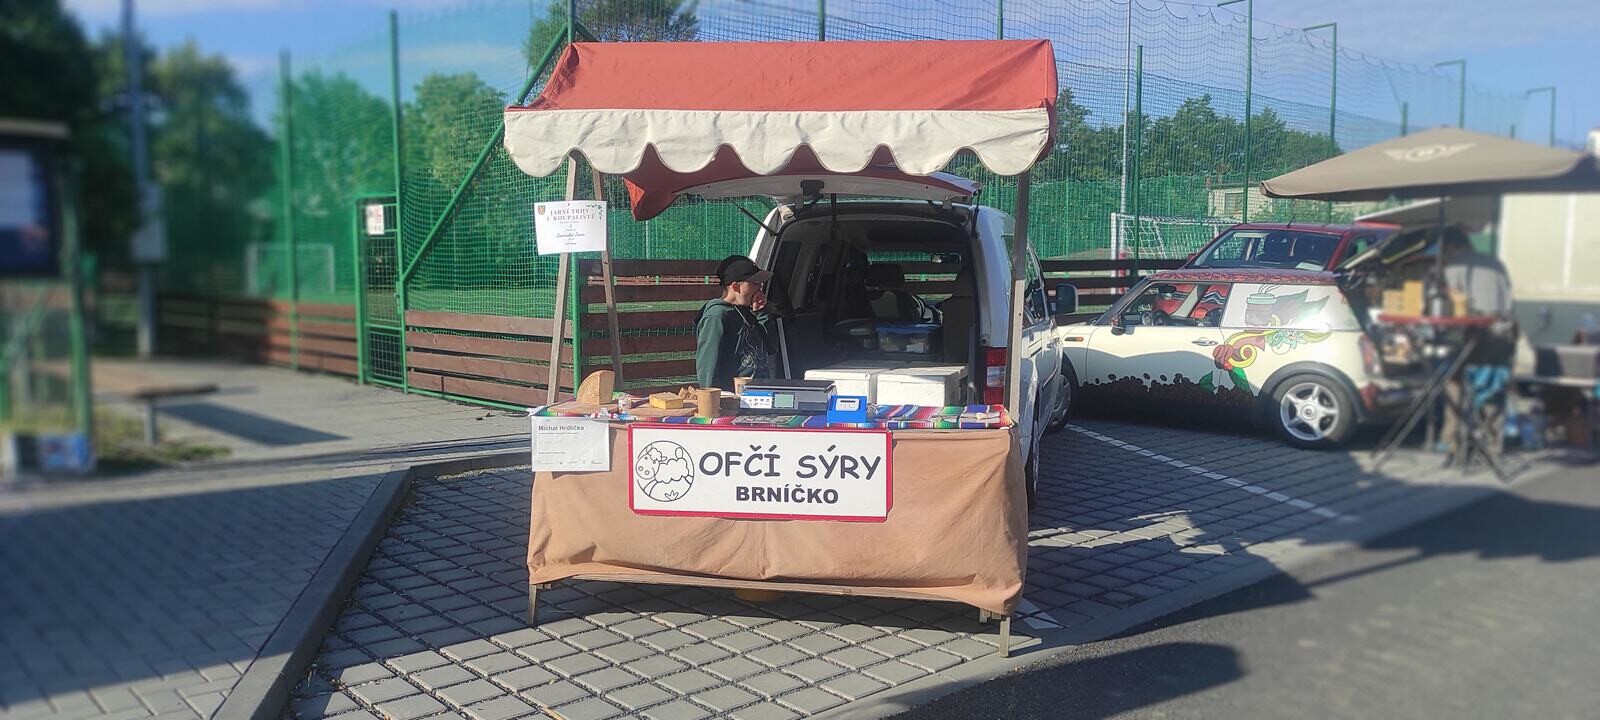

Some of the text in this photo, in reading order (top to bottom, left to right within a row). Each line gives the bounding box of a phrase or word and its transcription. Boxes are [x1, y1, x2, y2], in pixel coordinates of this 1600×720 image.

[699, 444, 882, 481] OFČÍ SÝRY
[735, 483, 839, 504] BRNÍČKO
